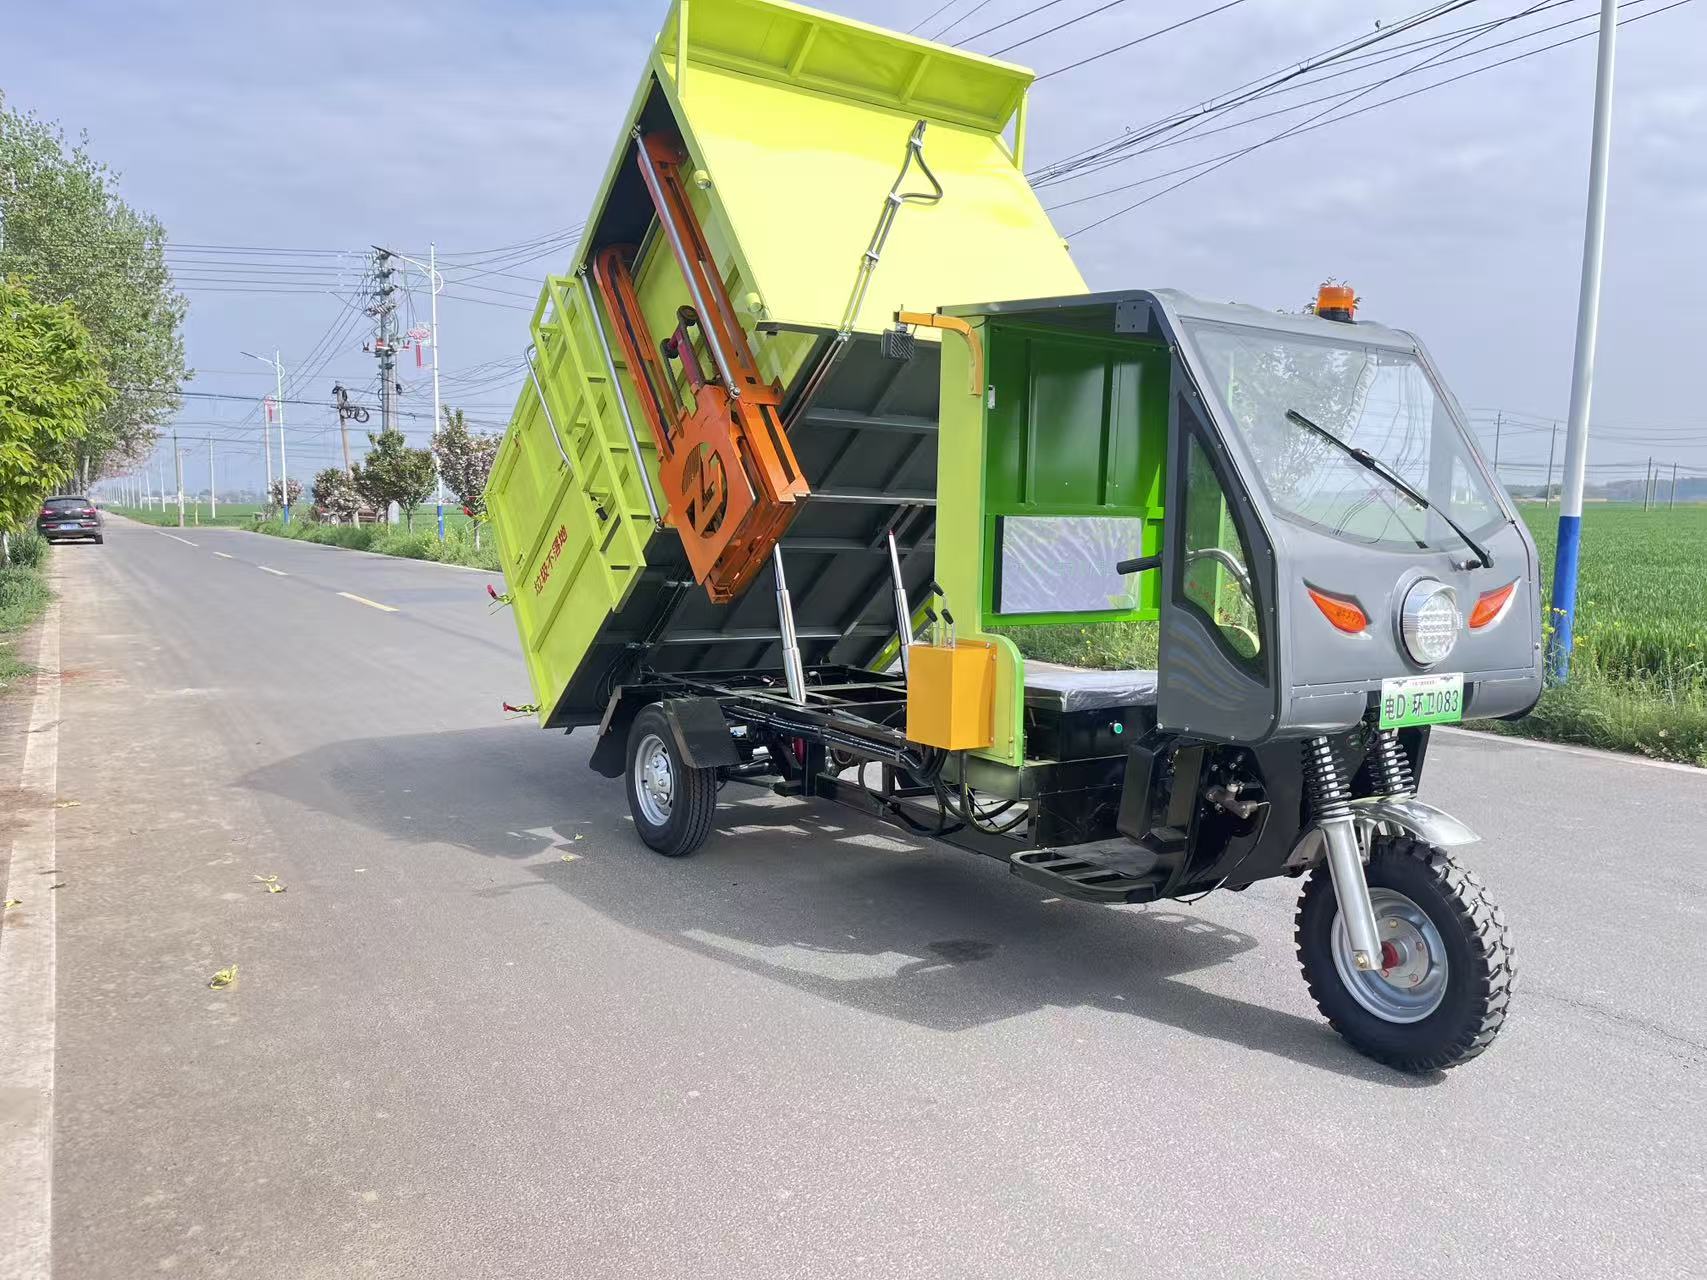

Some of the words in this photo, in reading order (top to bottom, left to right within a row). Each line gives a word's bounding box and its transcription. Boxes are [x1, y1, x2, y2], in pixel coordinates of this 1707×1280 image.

[534, 524, 567, 595] 垃圾不落地
